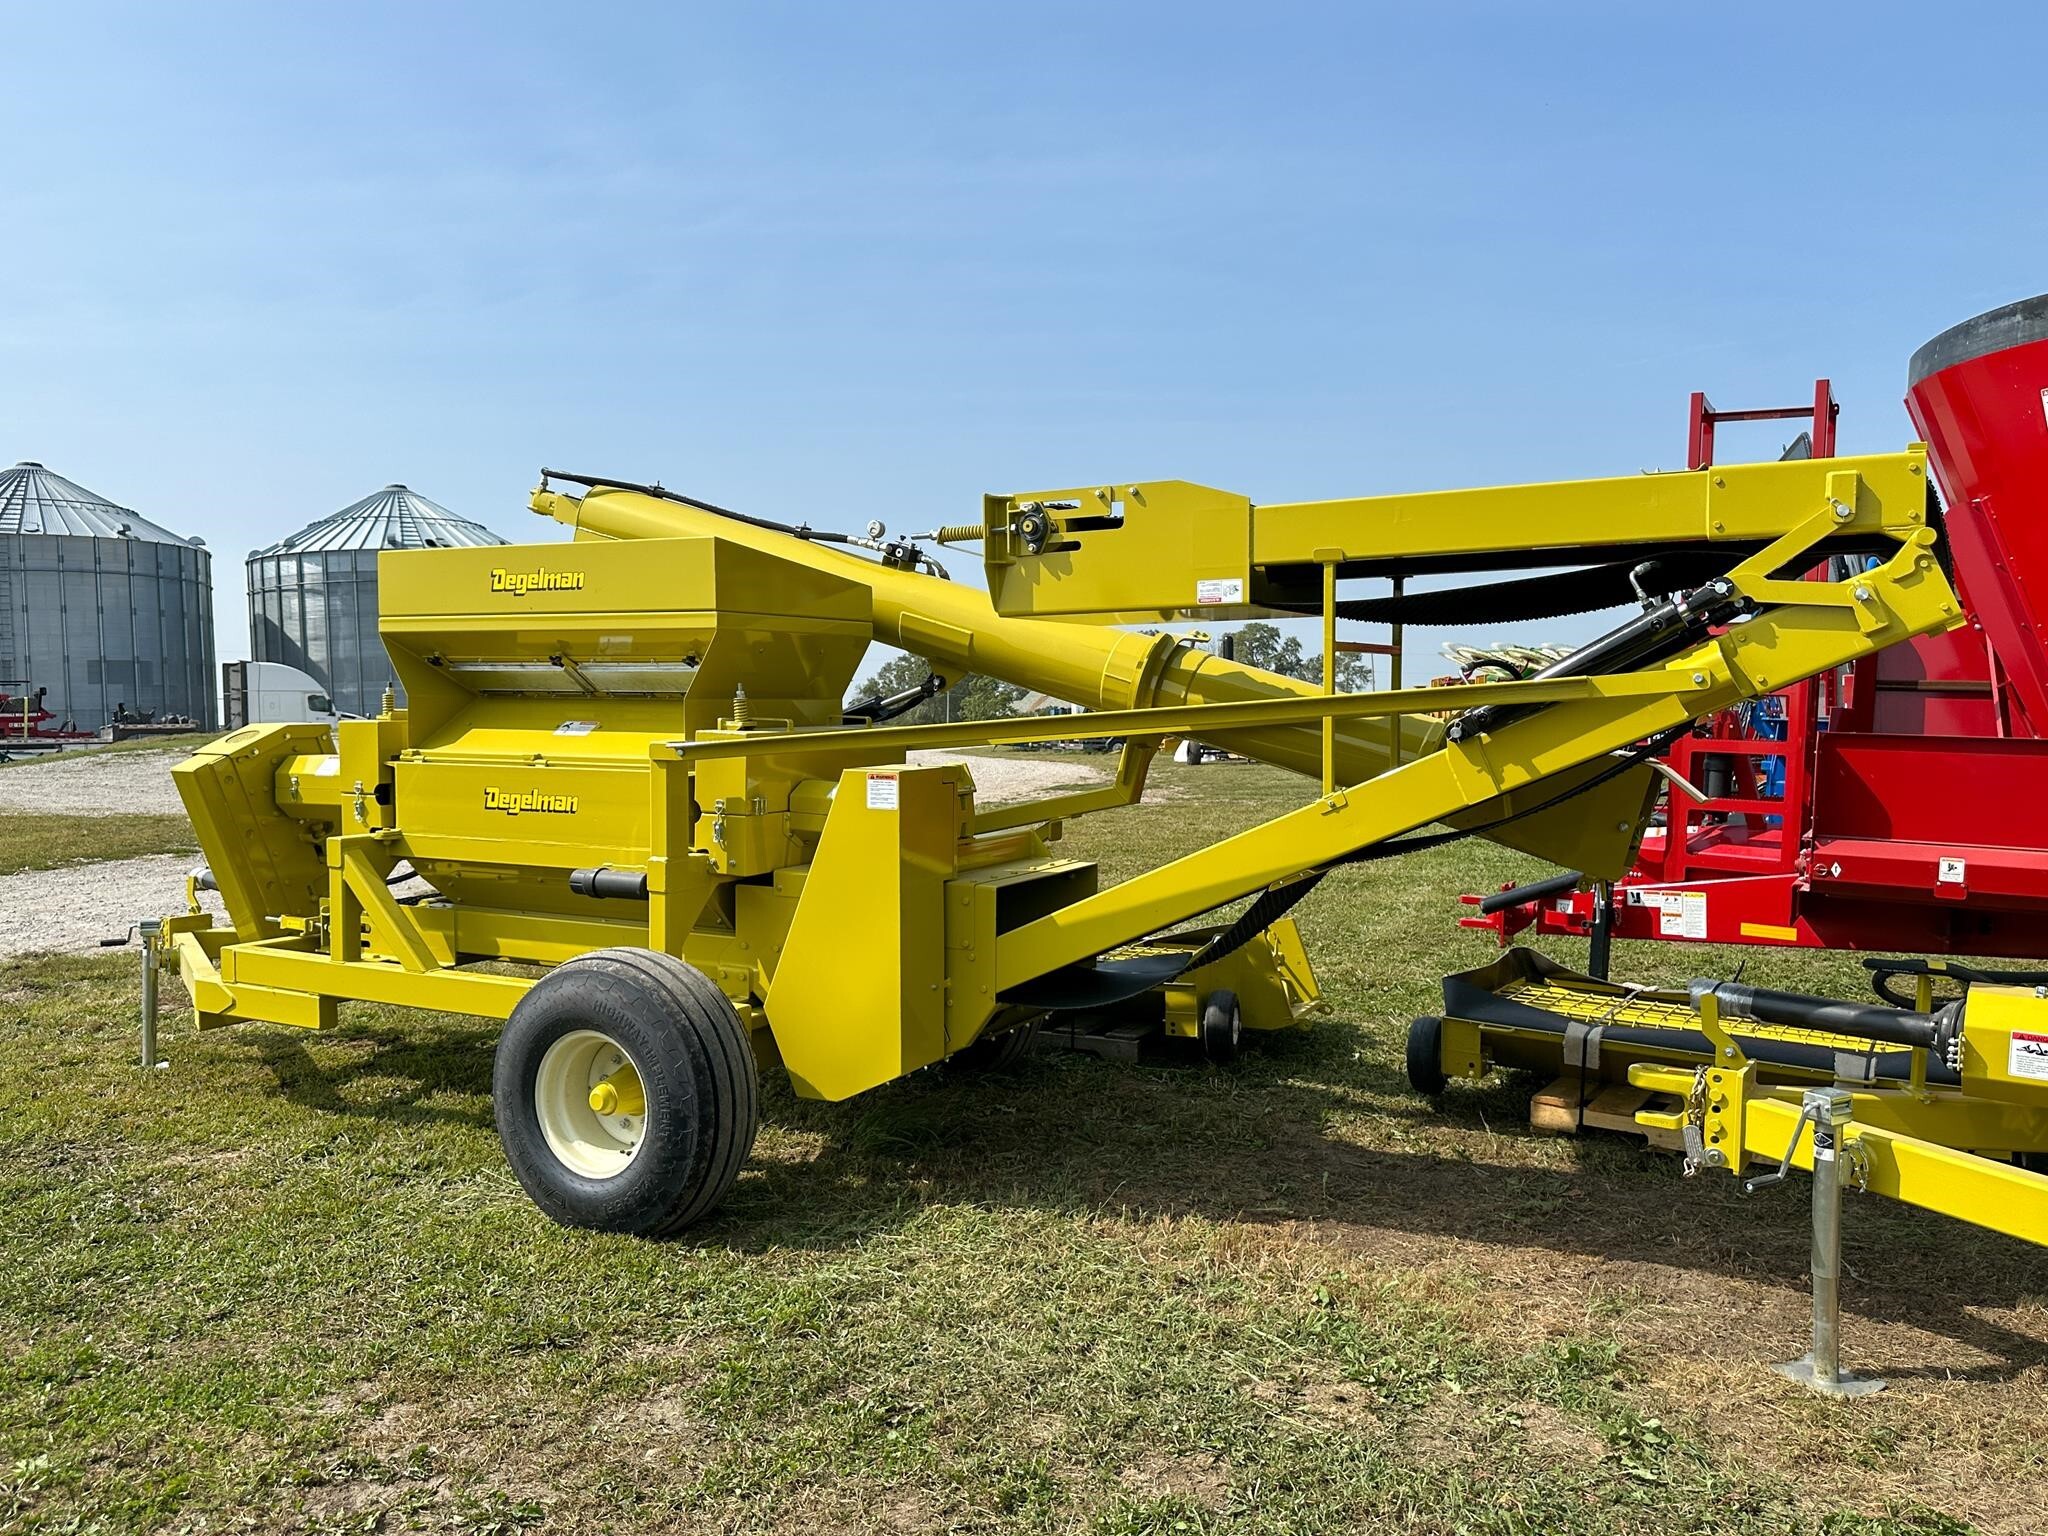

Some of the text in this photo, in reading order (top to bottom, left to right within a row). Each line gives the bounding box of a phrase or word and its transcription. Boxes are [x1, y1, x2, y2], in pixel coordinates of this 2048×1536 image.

[491, 567, 584, 596] Degelman
[484, 786, 578, 815] Degelman
[593, 999, 648, 1046] HIGHWAY
